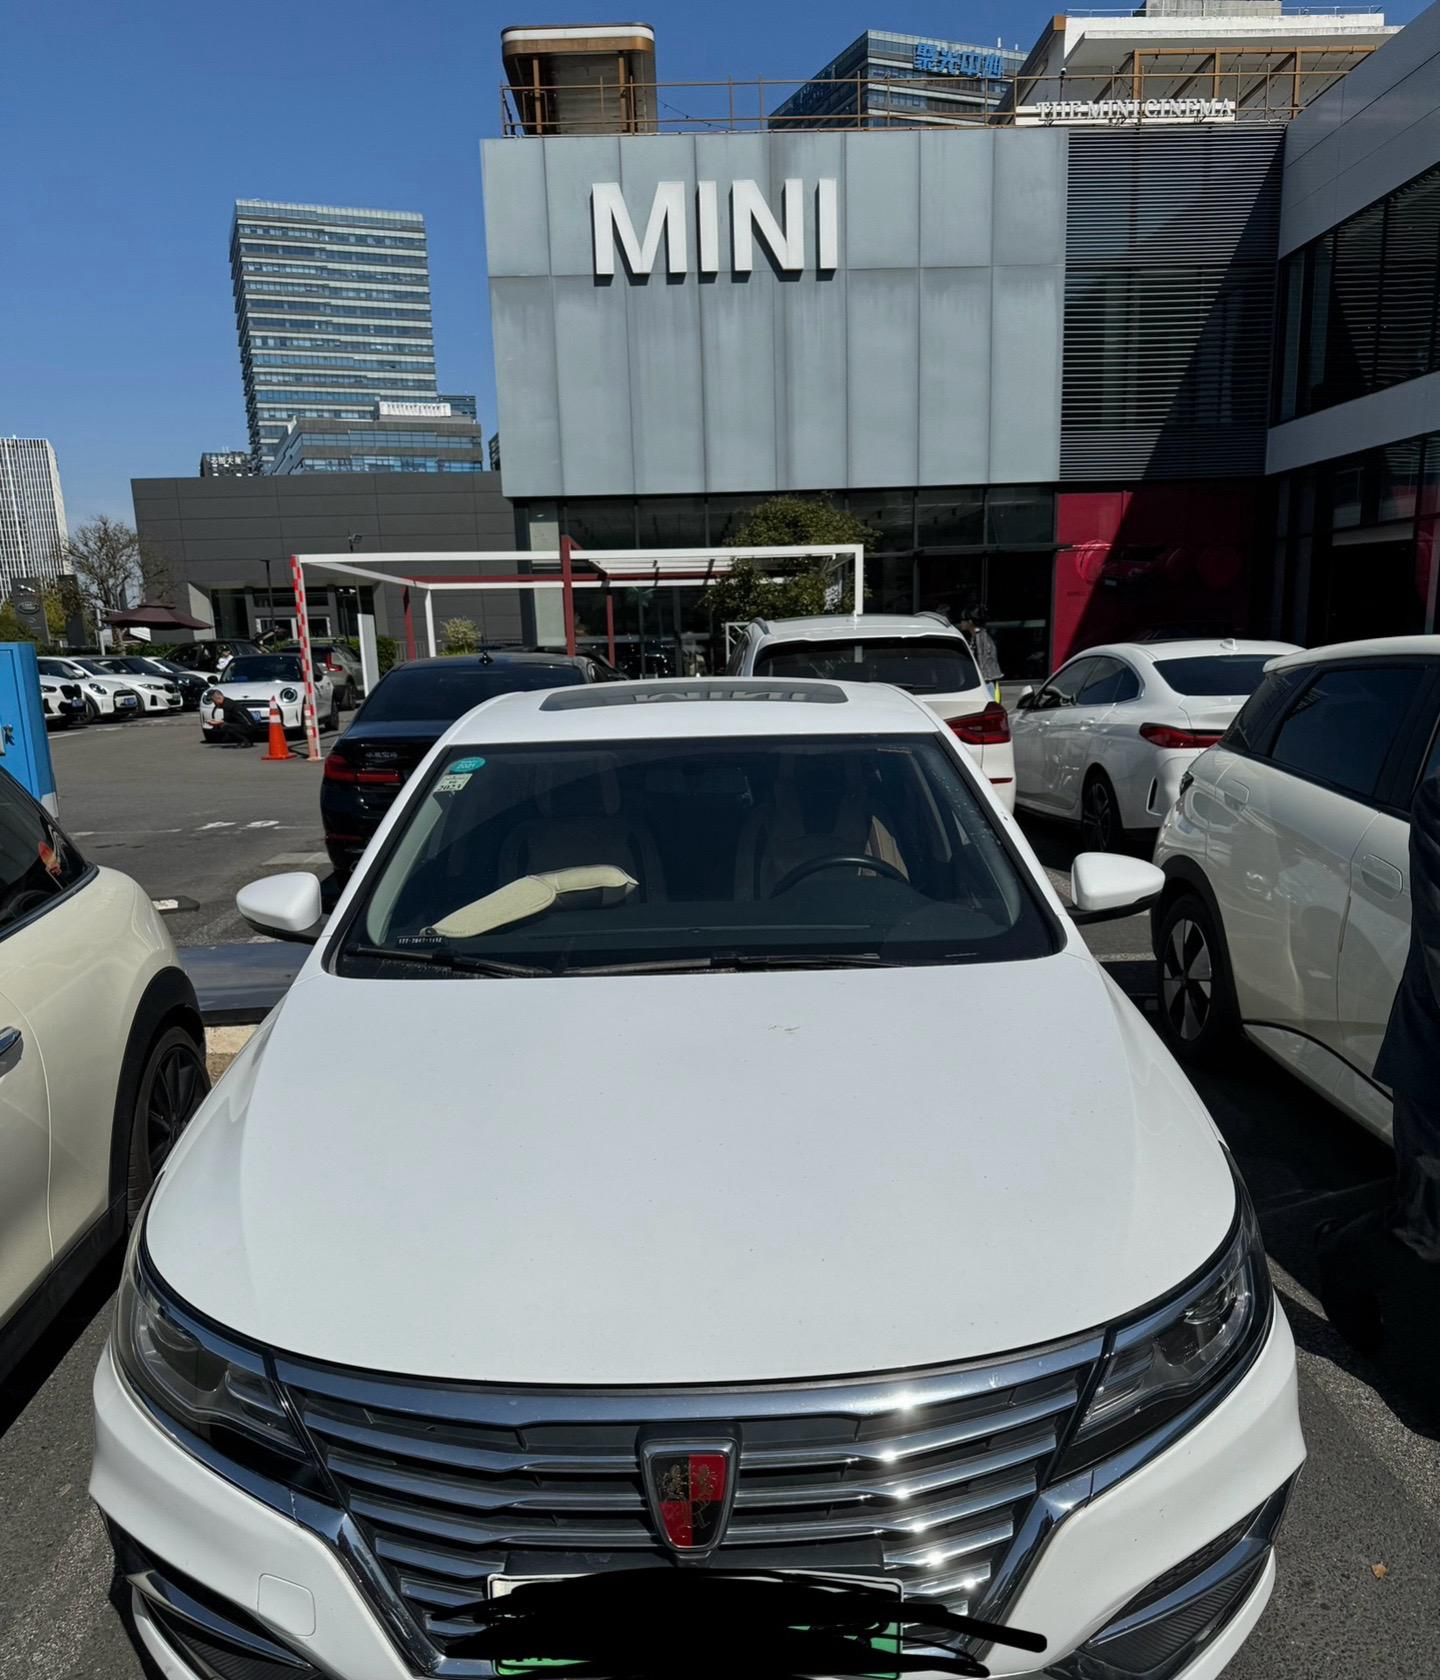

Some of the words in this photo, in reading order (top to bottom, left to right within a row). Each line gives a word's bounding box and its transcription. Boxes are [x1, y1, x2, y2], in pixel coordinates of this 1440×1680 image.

[1037, 101, 1082, 119] THE
[1087, 99, 1141, 118] MINI
[1145, 97, 1234, 117] CINEMA
[592, 178, 838, 275] MINI
